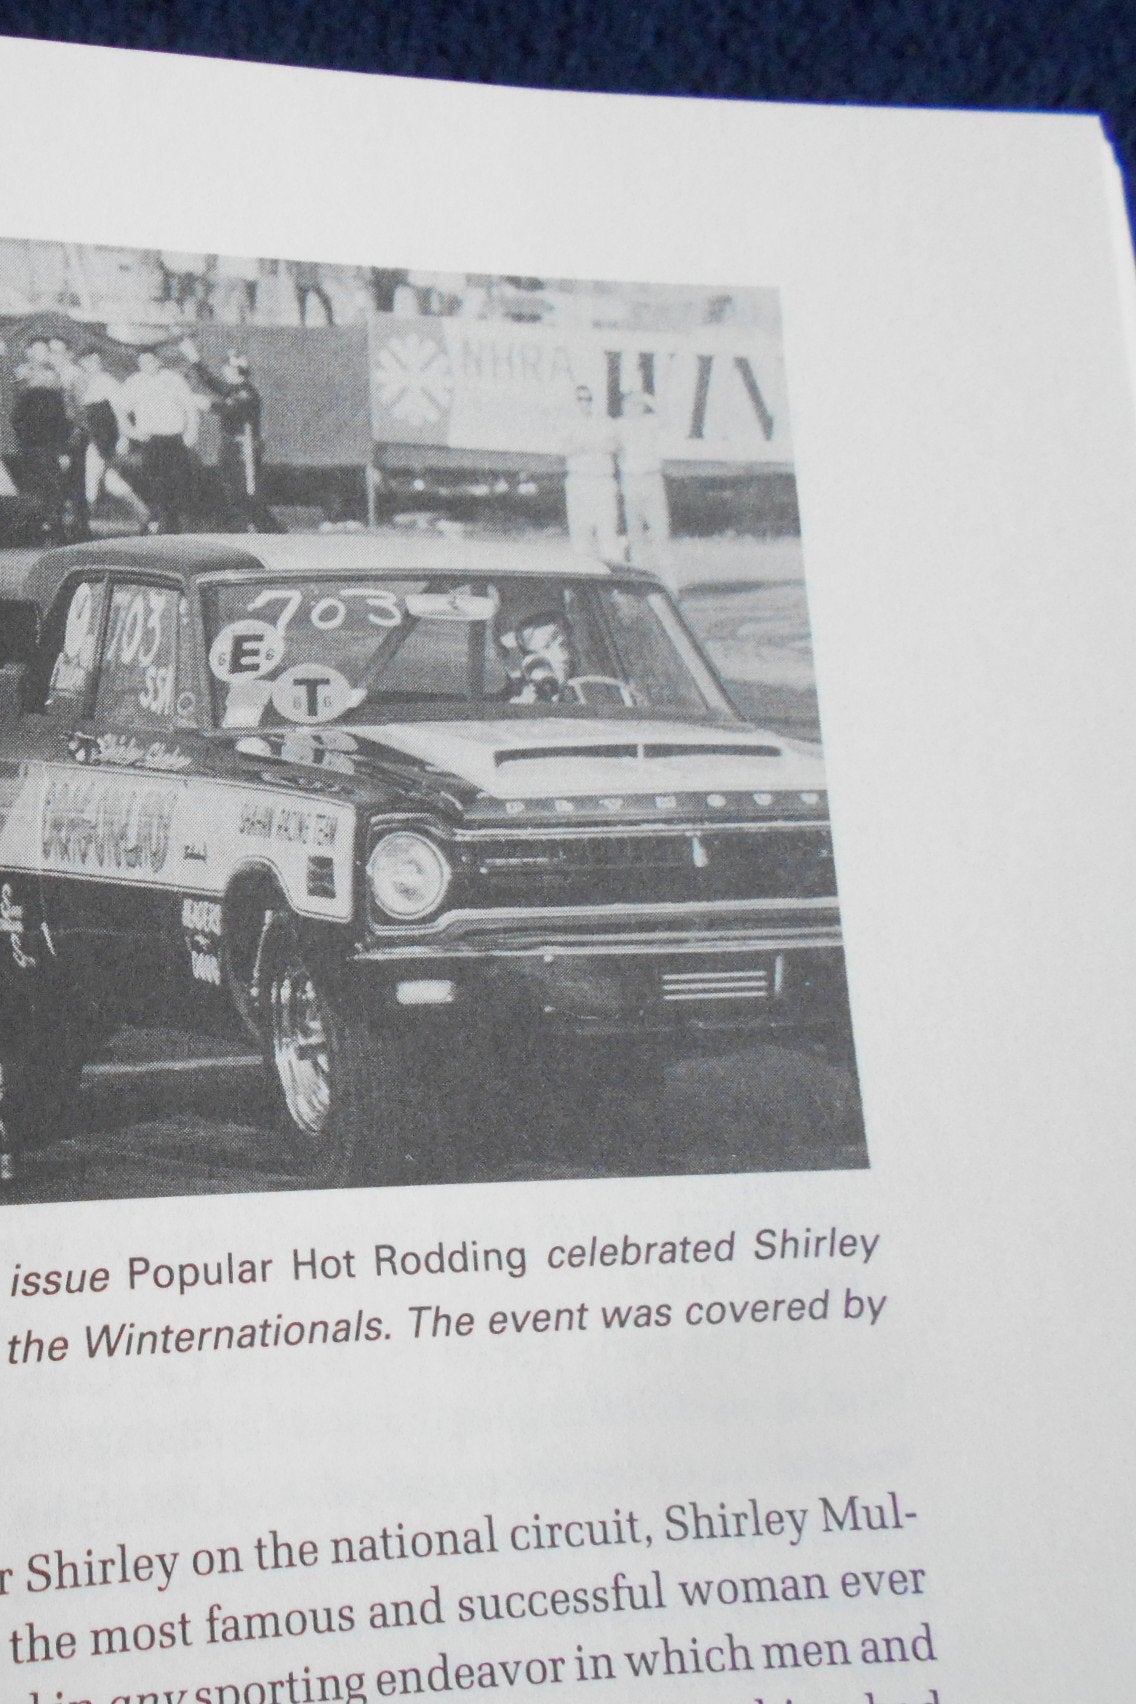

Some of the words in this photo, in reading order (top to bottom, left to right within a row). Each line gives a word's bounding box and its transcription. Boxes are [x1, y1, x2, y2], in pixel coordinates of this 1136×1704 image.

[228, 634, 265, 676] E
[293, 678, 331, 717] T
[11, 1263, 109, 1297] issue
[129, 1252, 273, 1295] Popular
[293, 1248, 356, 1280] Hot
[375, 1241, 526, 1278] Rodding
[548, 1231, 735, 1269] celebrated
[754, 1227, 880, 1264] Shirley
[8, 1330, 68, 1364] the
[86, 1309, 391, 1358] Winternationals.
[408, 1306, 474, 1338] The
[489, 1303, 589, 1335] event
[602, 1304, 672, 1329] was
[686, 1289, 829, 1326] covered
[844, 1288, 887, 1325] by
[27, 1544, 179, 1593] Shirley
[193, 1547, 243, 1576] on
[254, 1530, 318, 1570] the
[331, 1514, 498, 1564] national
[511, 1508, 652, 1551] circuit,
[665, 1499, 808, 1546] Shirley
[819, 1491, 917, 1532] Mul-
[9, 1622, 76, 1664] the
[90, 1613, 192, 1656] most
[206, 1603, 355, 1643] famous
[370, 1585, 445, 1629] and
[458, 1570, 666, 1622] successful
[678, 1574, 829, 1606] woman
[841, 1569, 926, 1598] ever
[195, 1666, 367, 1704] sporting
[377, 1652, 565, 1696] endeavor
[575, 1645, 616, 1681] in
[624, 1633, 754, 1677] which
[762, 1640, 851, 1669] men
[861, 1622, 938, 1664] and
